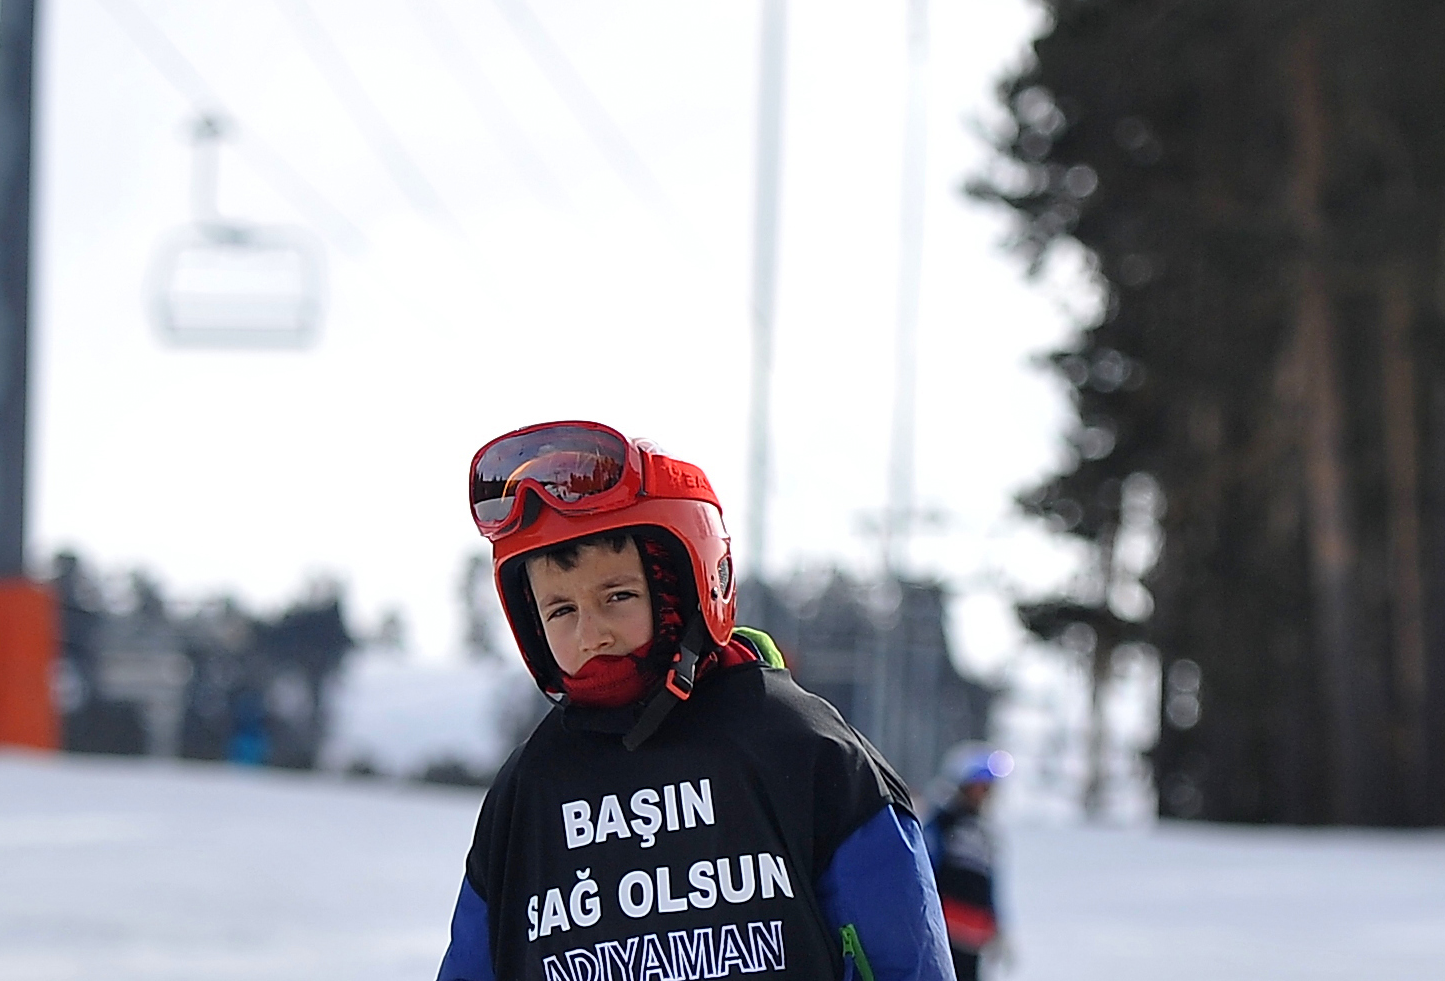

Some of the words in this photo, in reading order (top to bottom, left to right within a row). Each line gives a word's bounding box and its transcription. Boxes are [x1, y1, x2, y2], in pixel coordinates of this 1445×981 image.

[562, 778, 715, 849] BAŞIN
[528, 867, 602, 942] SAĞ
[618, 852, 794, 918] OLSUN
